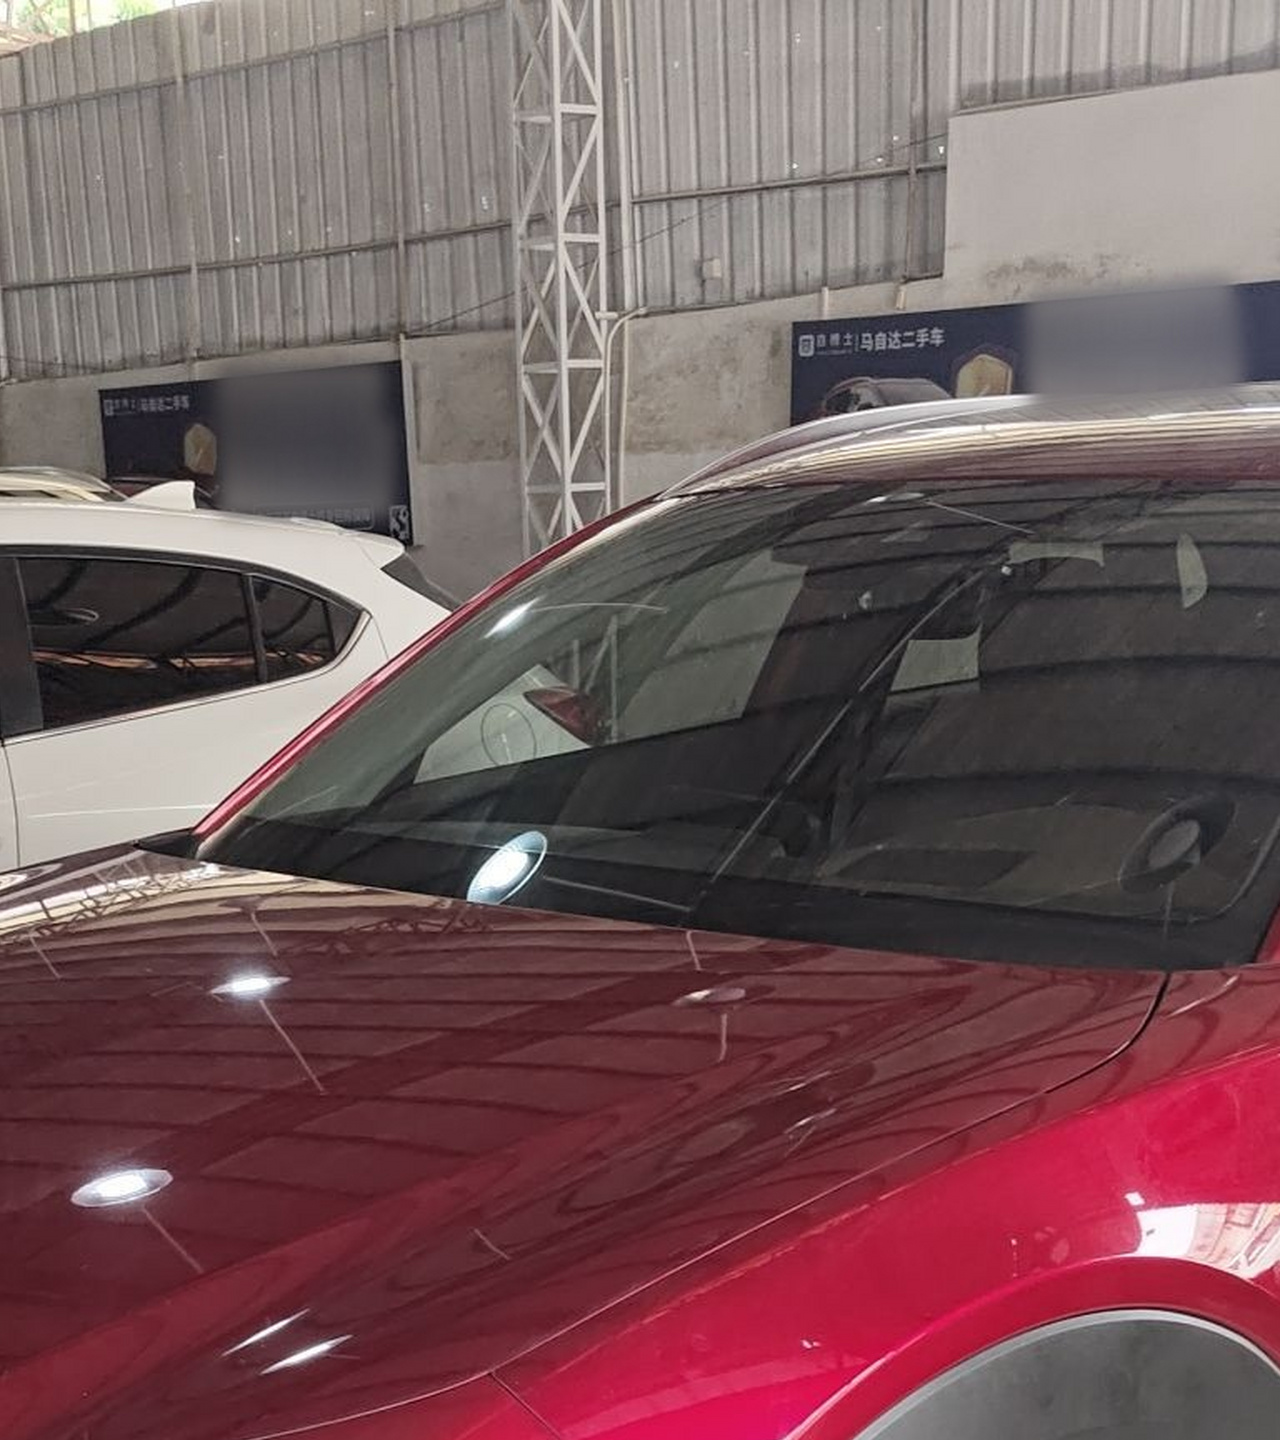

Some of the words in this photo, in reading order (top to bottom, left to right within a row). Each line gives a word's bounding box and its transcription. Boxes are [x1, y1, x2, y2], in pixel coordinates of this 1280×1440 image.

[860, 327, 945, 351] 马自达二手车
